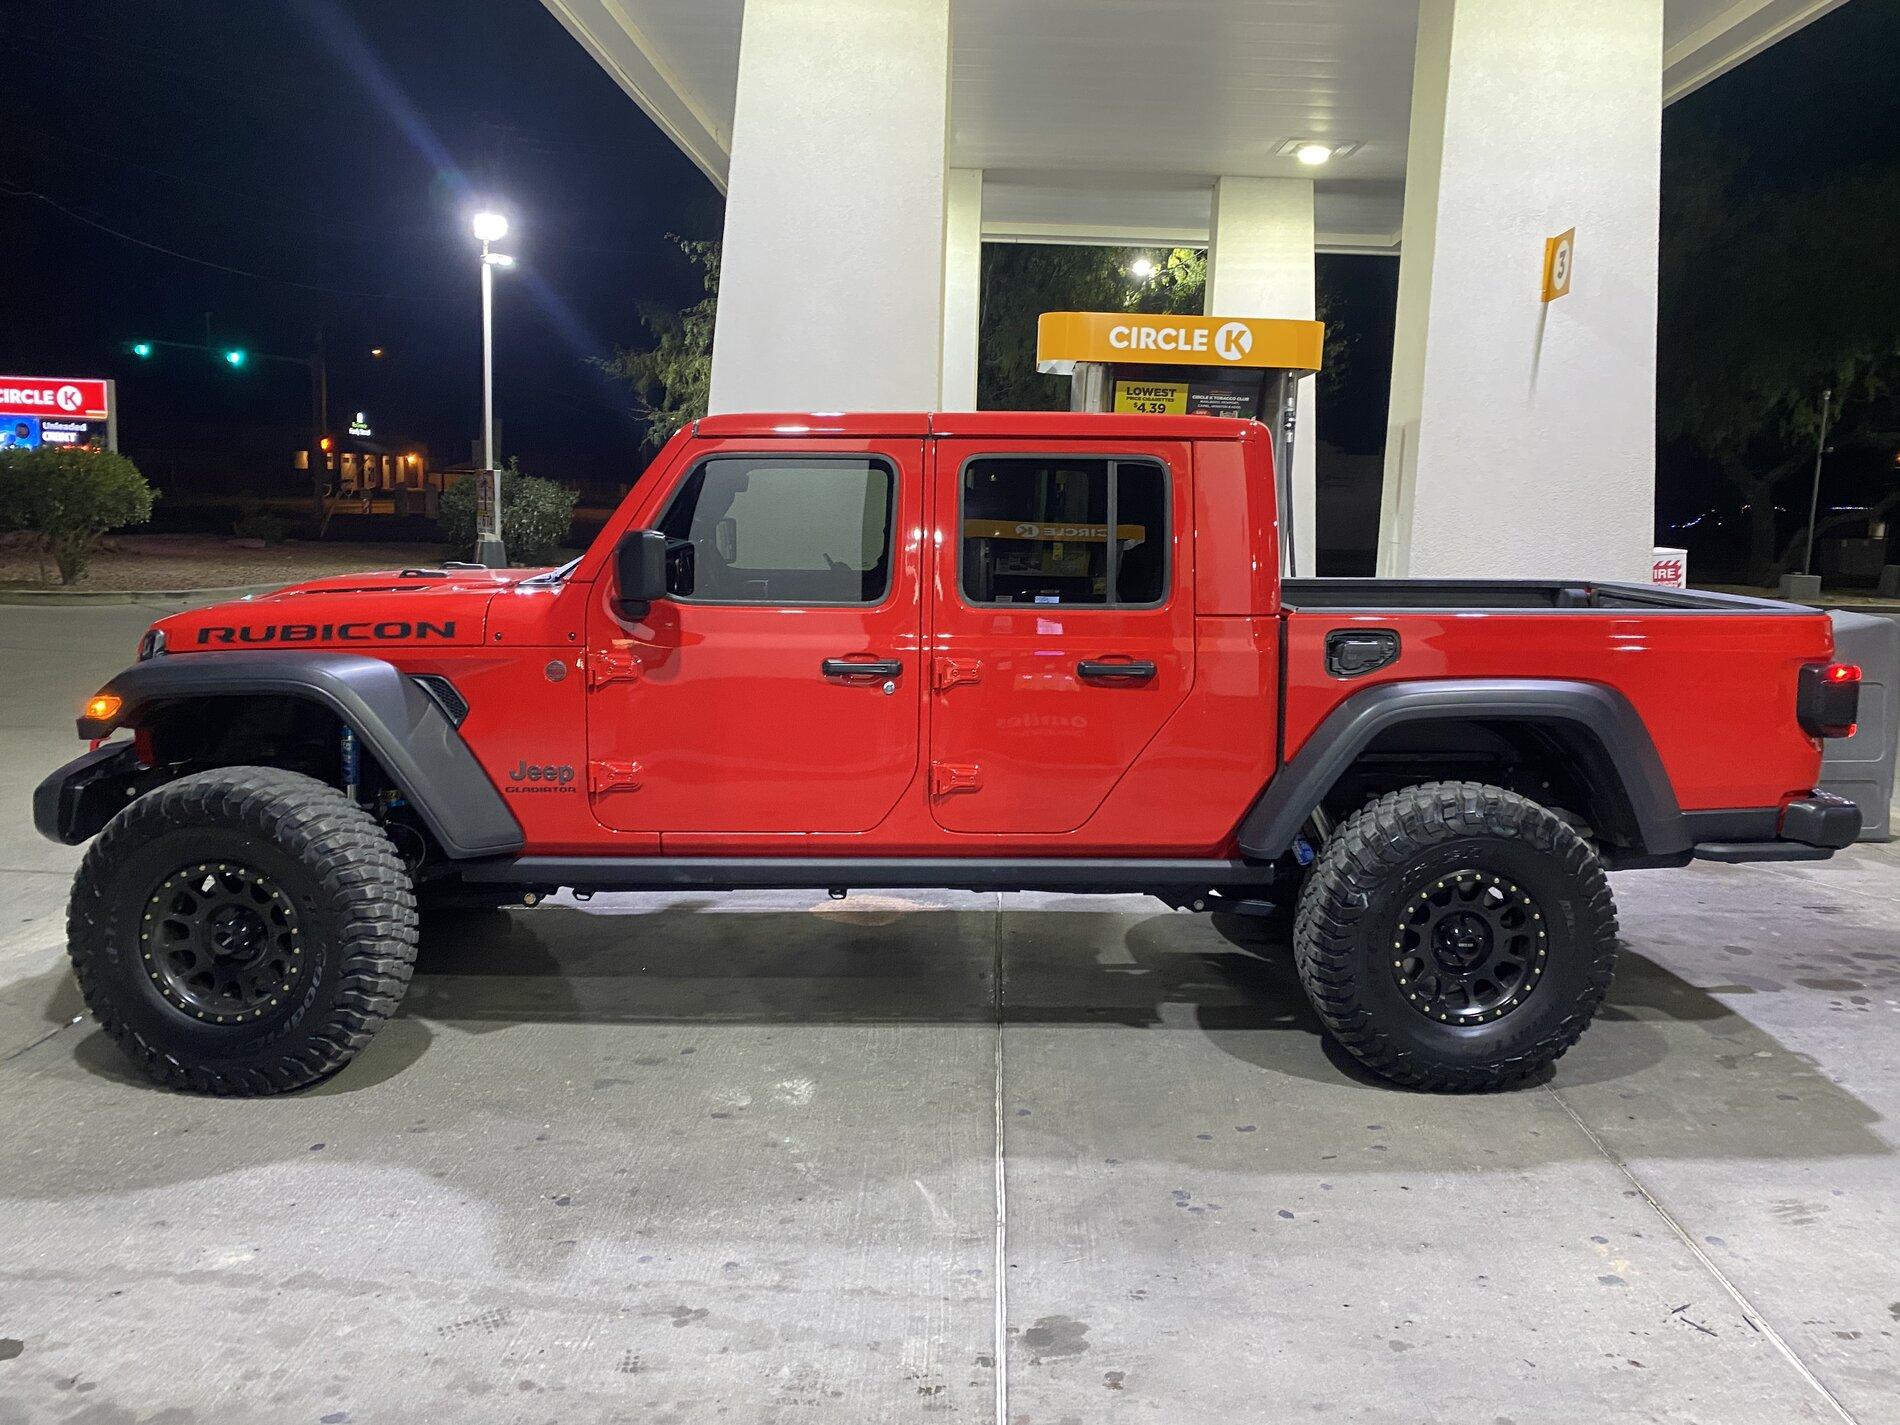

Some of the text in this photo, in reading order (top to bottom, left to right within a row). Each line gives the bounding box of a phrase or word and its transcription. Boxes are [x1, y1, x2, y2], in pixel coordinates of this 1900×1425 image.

[1557, 250, 1567, 279] 3
[1108, 325, 1251, 360] CIRCLE K
[59, 387, 82, 411] K
[1126, 386, 1177, 397] LOWEST
[1133, 402, 1166, 413] $4.39
[1653, 568, 1676, 579] IRE
[197, 621, 456, 644] RUBICON
[509, 760, 575, 785] Jeep
